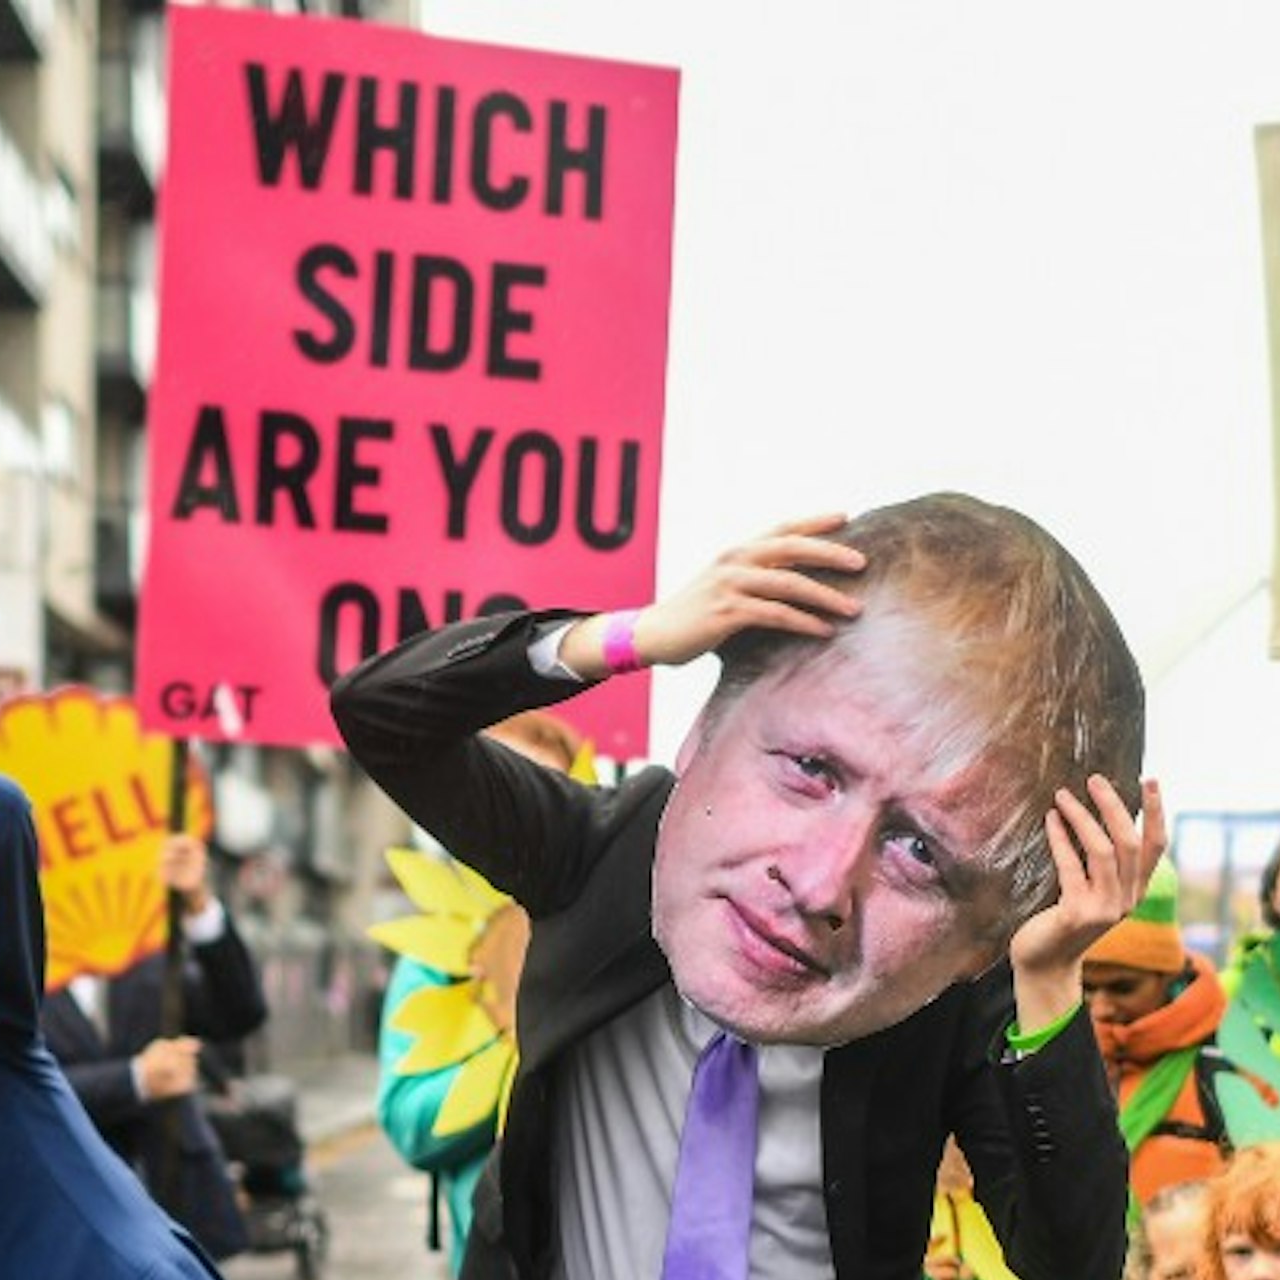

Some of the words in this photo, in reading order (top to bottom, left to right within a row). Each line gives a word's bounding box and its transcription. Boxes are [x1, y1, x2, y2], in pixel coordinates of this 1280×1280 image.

[242, 60, 608, 222] WHICH
[291, 242, 549, 383] SIDE
[170, 402, 396, 537] ARE
[428, 421, 641, 553] YOU
[316, 582, 530, 690] ON
[40, 773, 167, 871] ELL
